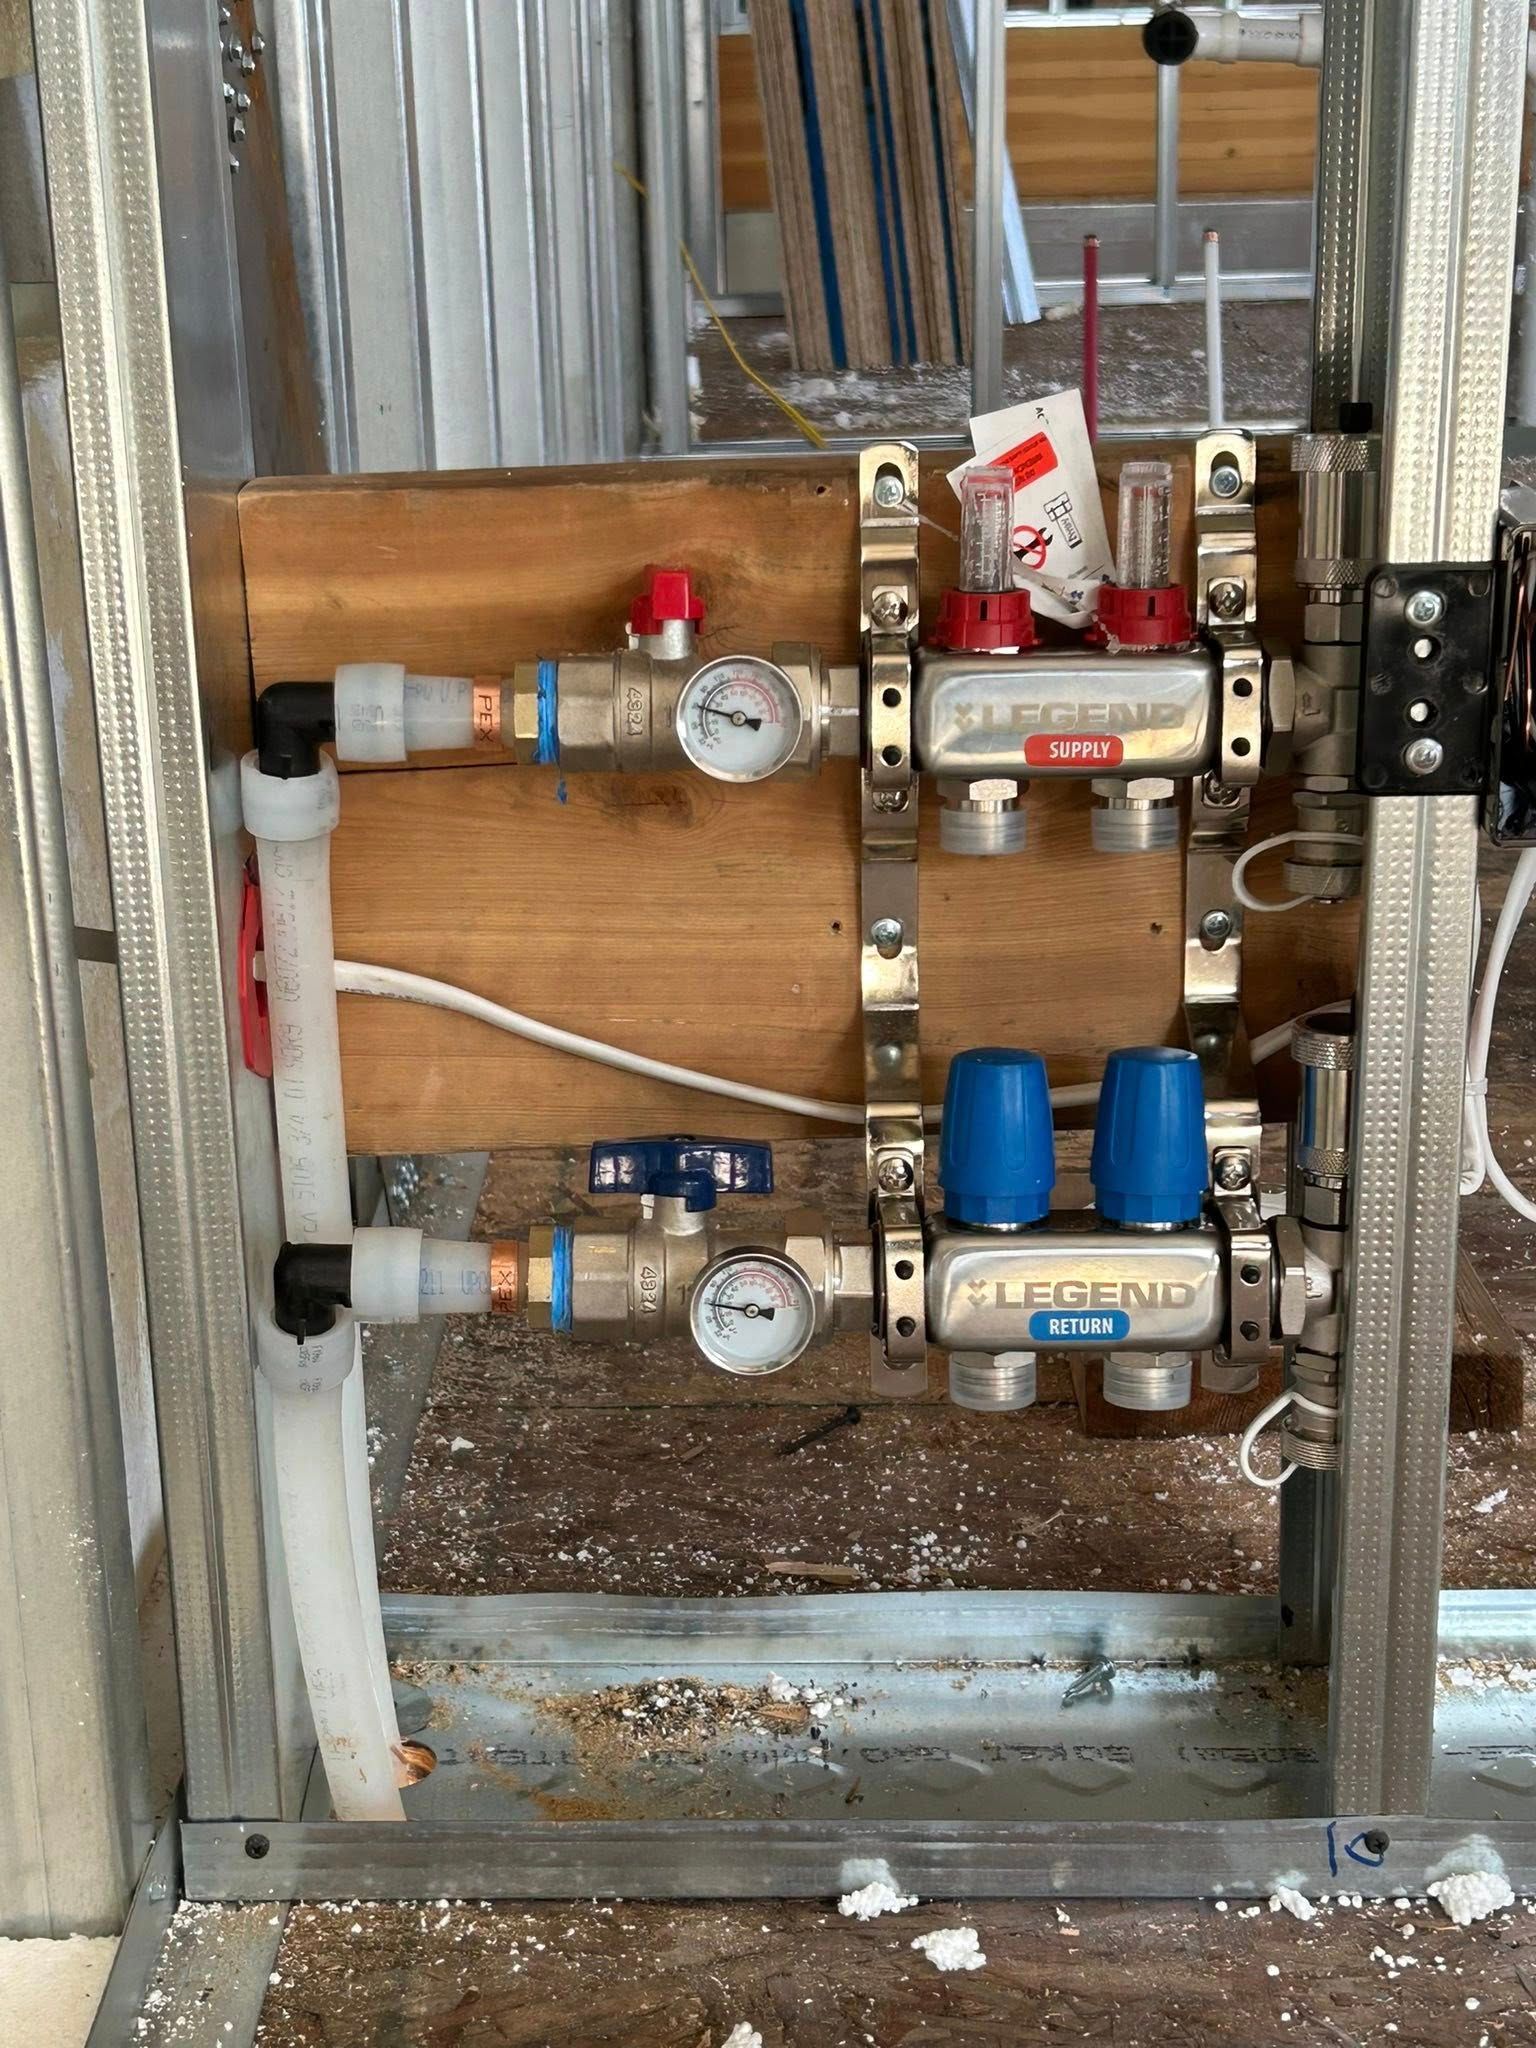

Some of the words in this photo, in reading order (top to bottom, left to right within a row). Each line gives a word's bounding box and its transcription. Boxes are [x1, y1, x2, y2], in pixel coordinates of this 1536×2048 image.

[477, 694, 494, 744] PEX
[982, 702, 1188, 731] LEGEND
[1049, 740, 1111, 759] SUPPLY
[498, 1268, 513, 1312] PEX
[995, 1280, 1196, 1309] LEGEND
[1049, 1318, 1113, 1336] RETURN
